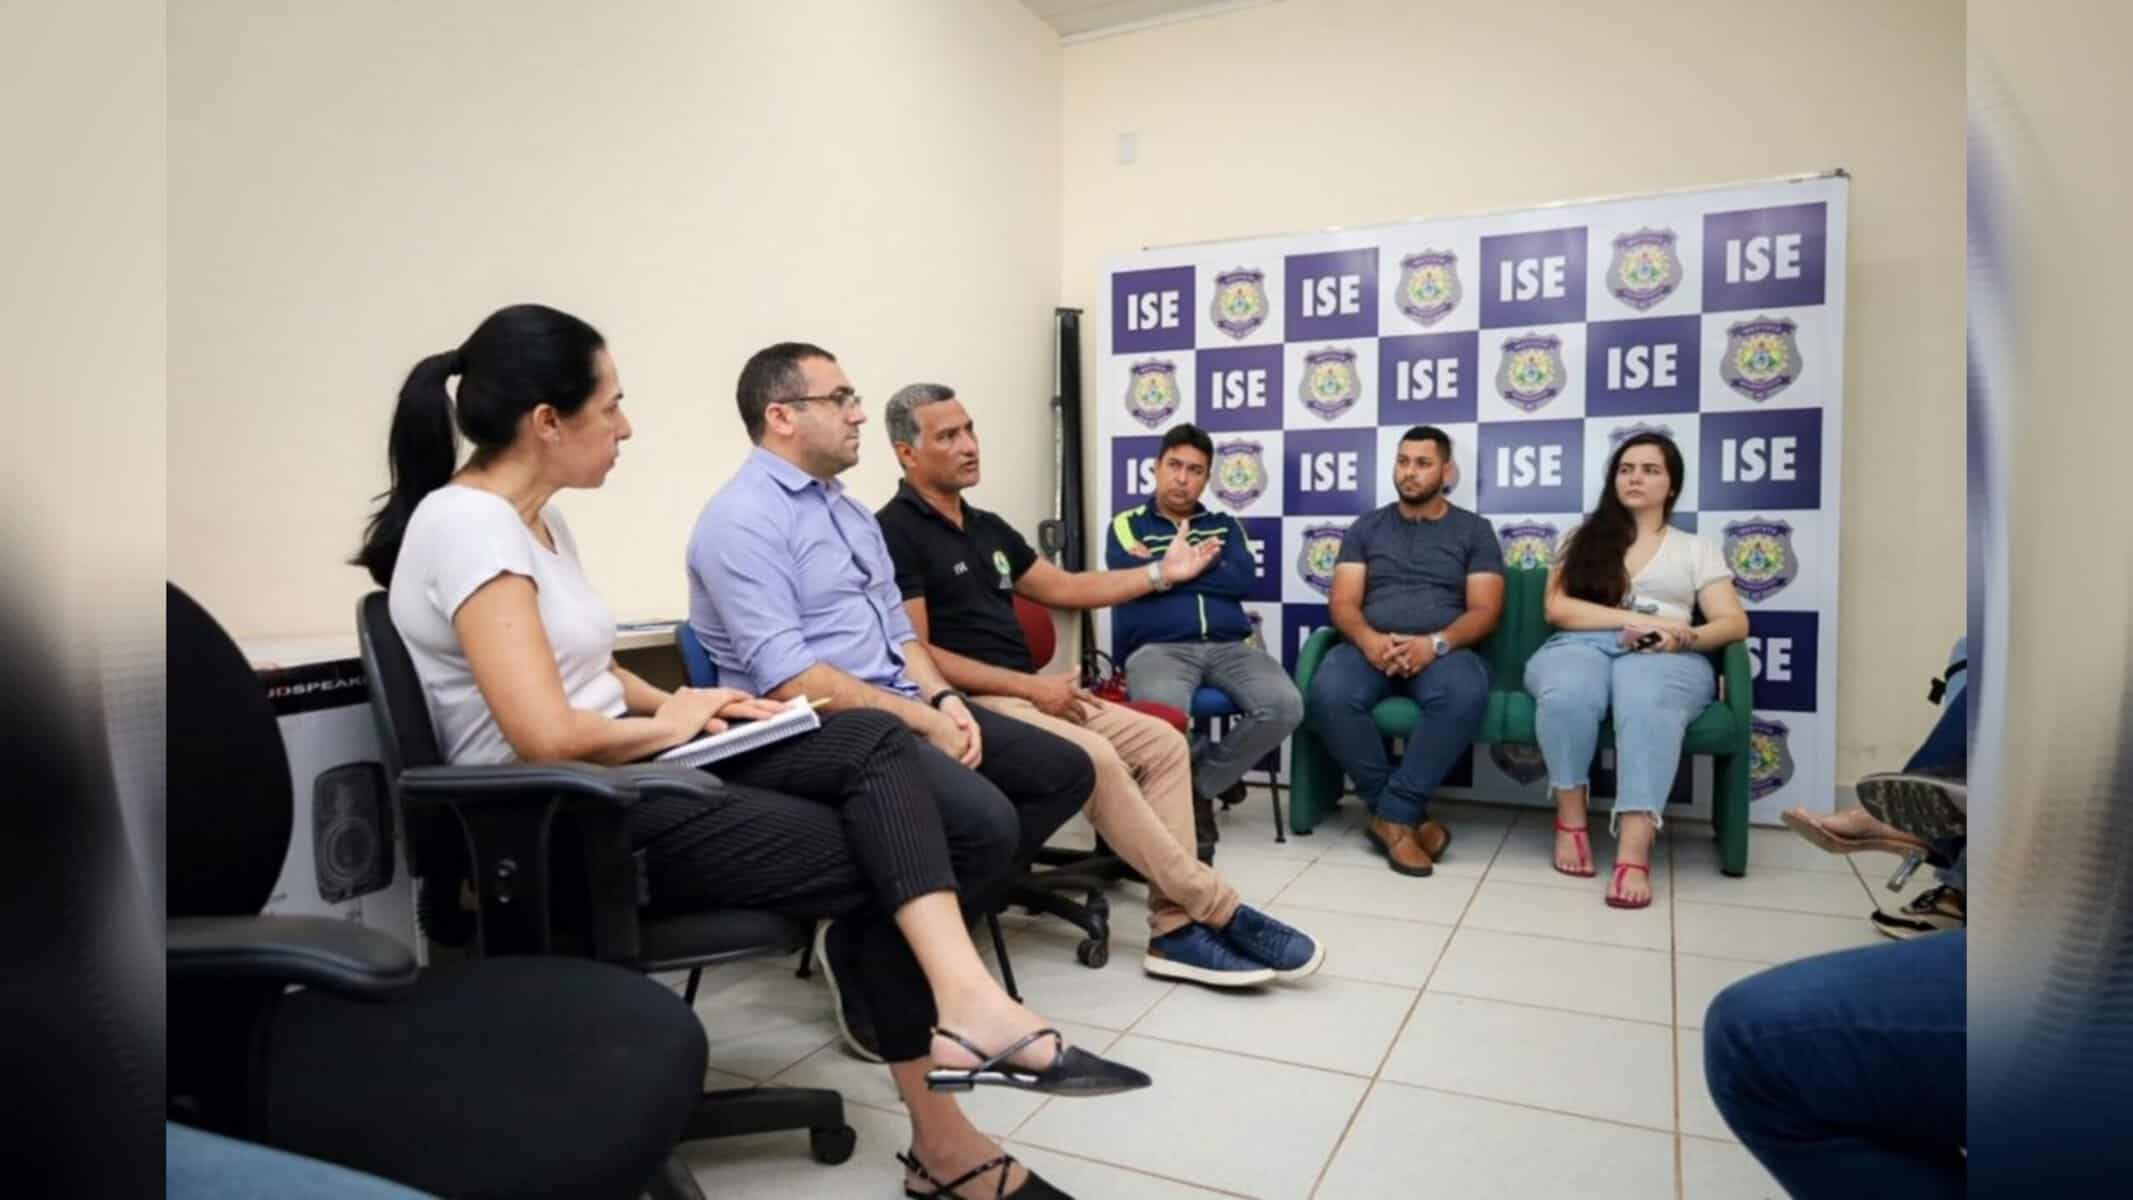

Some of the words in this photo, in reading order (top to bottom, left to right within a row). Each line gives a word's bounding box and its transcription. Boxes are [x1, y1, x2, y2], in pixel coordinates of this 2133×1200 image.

[1500, 256, 1566, 302] ISE
[1726, 234, 1802, 283] ISE
[1127, 291, 1179, 330] ISE
[1302, 275, 1360, 317] ISE
[1397, 358, 1458, 400] ISE
[1608, 344, 1678, 389] ISE
[1212, 370, 1266, 409] ISE
[1127, 457, 1156, 495] IS
[1300, 452, 1358, 491] ISE
[1496, 445, 1562, 487] ISE
[1721, 437, 1797, 482] ISE
